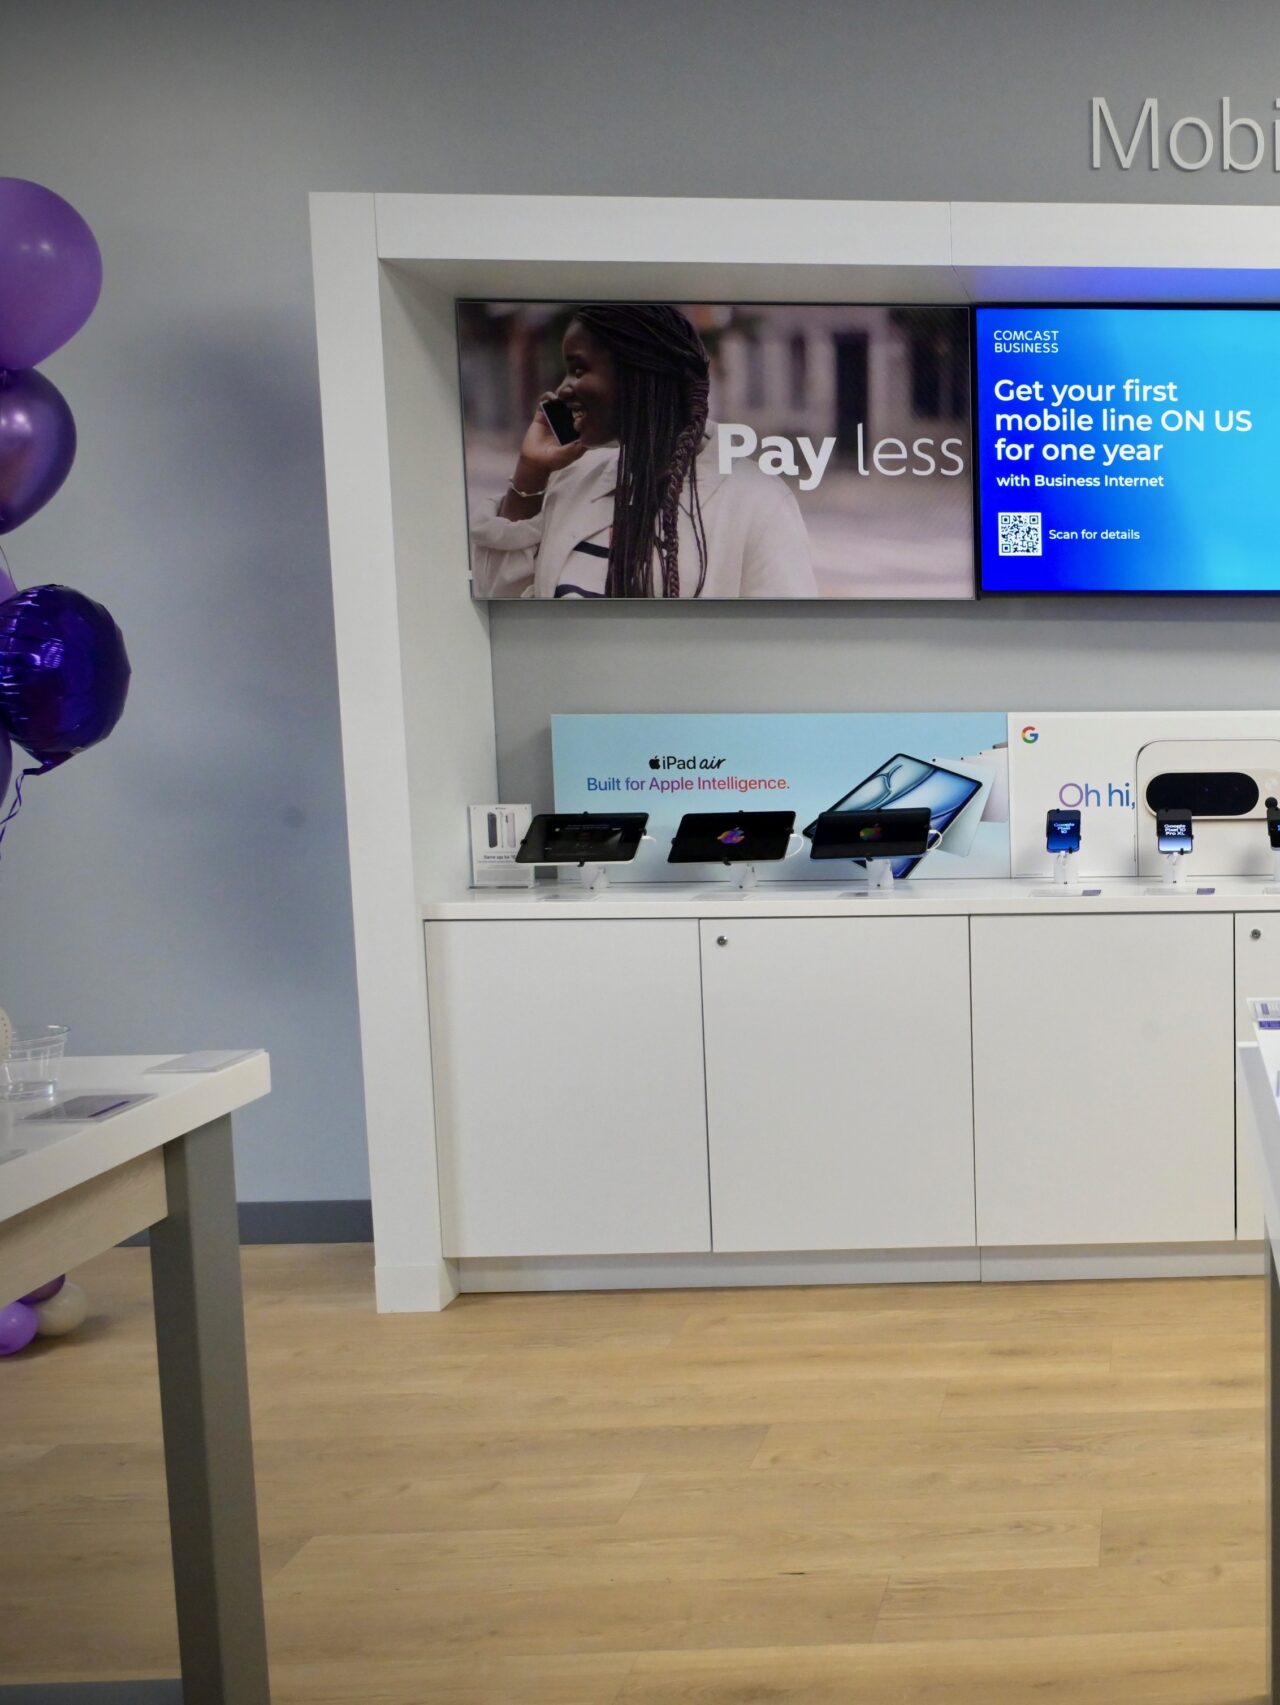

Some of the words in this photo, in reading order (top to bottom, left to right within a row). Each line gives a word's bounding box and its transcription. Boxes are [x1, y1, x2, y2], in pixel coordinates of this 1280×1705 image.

[993, 330, 1060, 341] COMCAST
[993, 343, 1060, 354] BUSINESS
[994, 379, 1045, 402] Get
[1051, 384, 1116, 407] your
[1122, 378, 1179, 402] first
[995, 408, 1094, 432] mobile
[1102, 408, 1152, 432] line
[1160, 409, 1205, 432] ON
[1214, 410, 1253, 432] US
[717, 423, 837, 491] Pay
[857, 422, 965, 477] less
[994, 437, 1035, 461] for
[1041, 443, 1096, 461] one
[1102, 443, 1164, 467] year
[996, 474, 1031, 487] with
[1034, 474, 1101, 487] Business
[1104, 474, 1164, 487] Internet
[1048, 529, 1079, 540] Scan
[1081, 529, 1098, 540] for
[1100, 529, 1141, 540] details
[662, 755, 697, 770] iPad
[699, 757, 726, 770] air
[587, 776, 621, 791] Built
[625, 776, 646, 790] for
[649, 776, 694, 793] Apple
[697, 776, 791, 793] Intelligence.
[1058, 782, 1101, 808] Oh
[1108, 783, 1136, 810] hi,
